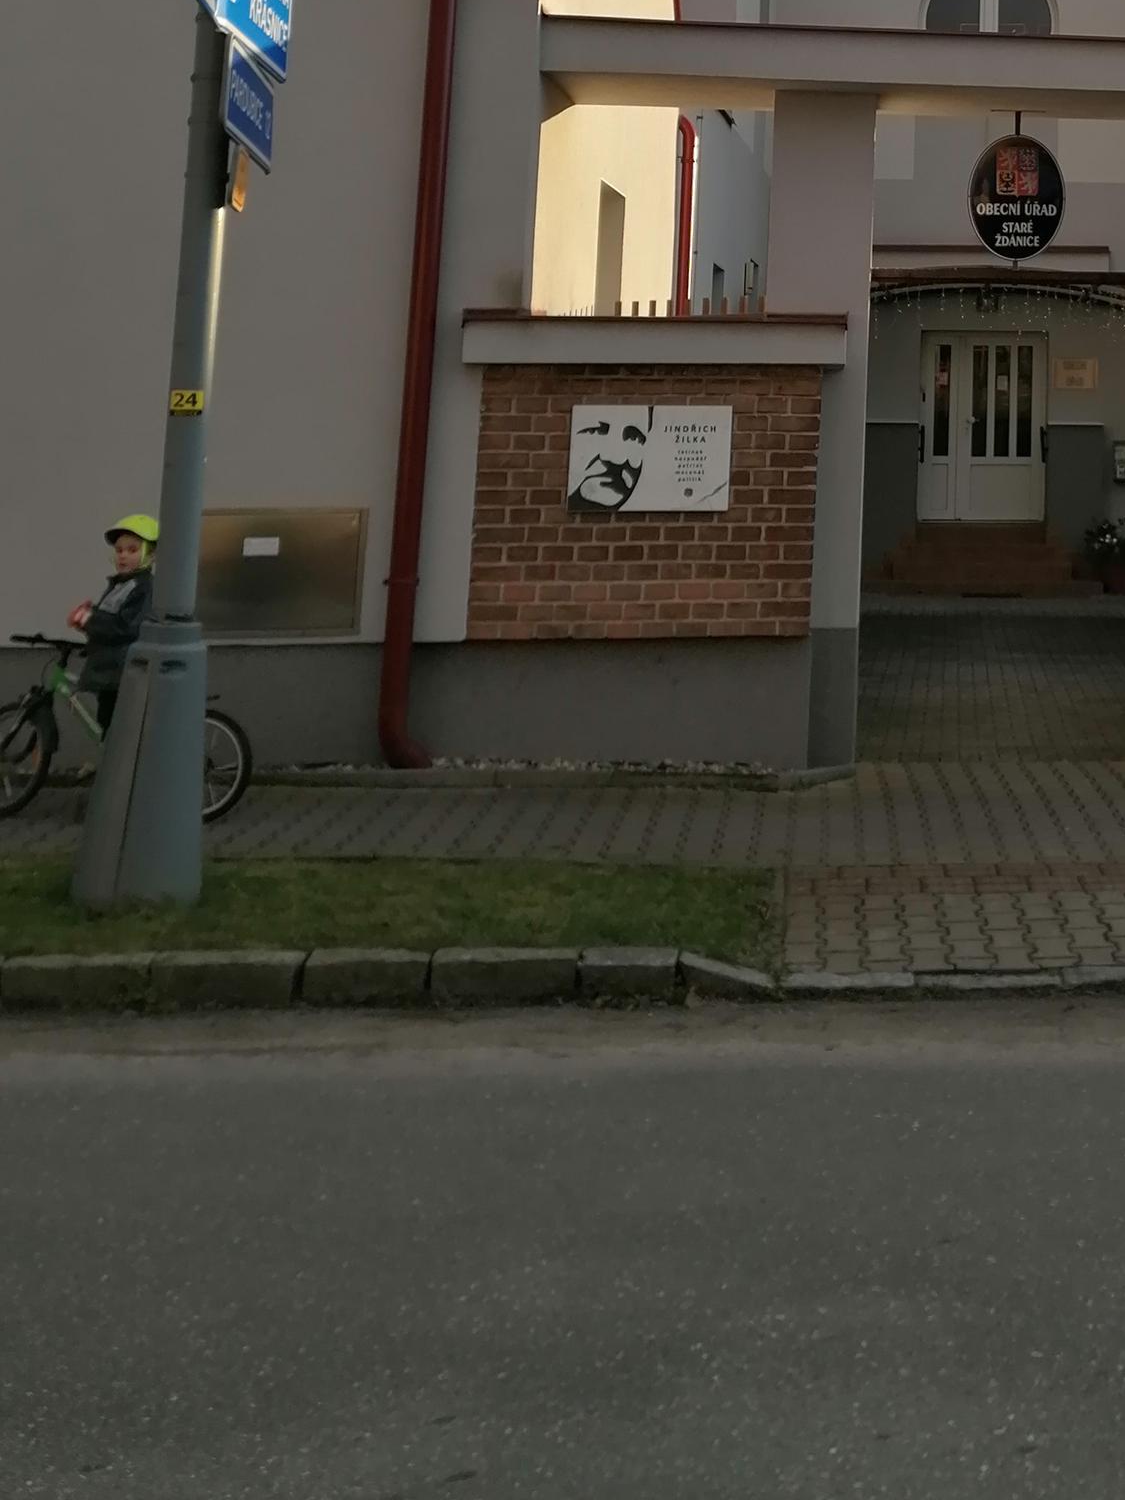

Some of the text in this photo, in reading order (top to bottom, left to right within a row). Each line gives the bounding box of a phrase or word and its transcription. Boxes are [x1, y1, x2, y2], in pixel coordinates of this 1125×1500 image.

[976, 200, 1058, 216] OBECNÍ ÚŘAD
[1002, 220, 1034, 234] STARÉ
[994, 233, 1040, 247] ŽDÁNICE
[174, 392, 198, 408] 24
[663, 424, 717, 433] JINDŘICH
[674, 434, 706, 443] ŽILKA
